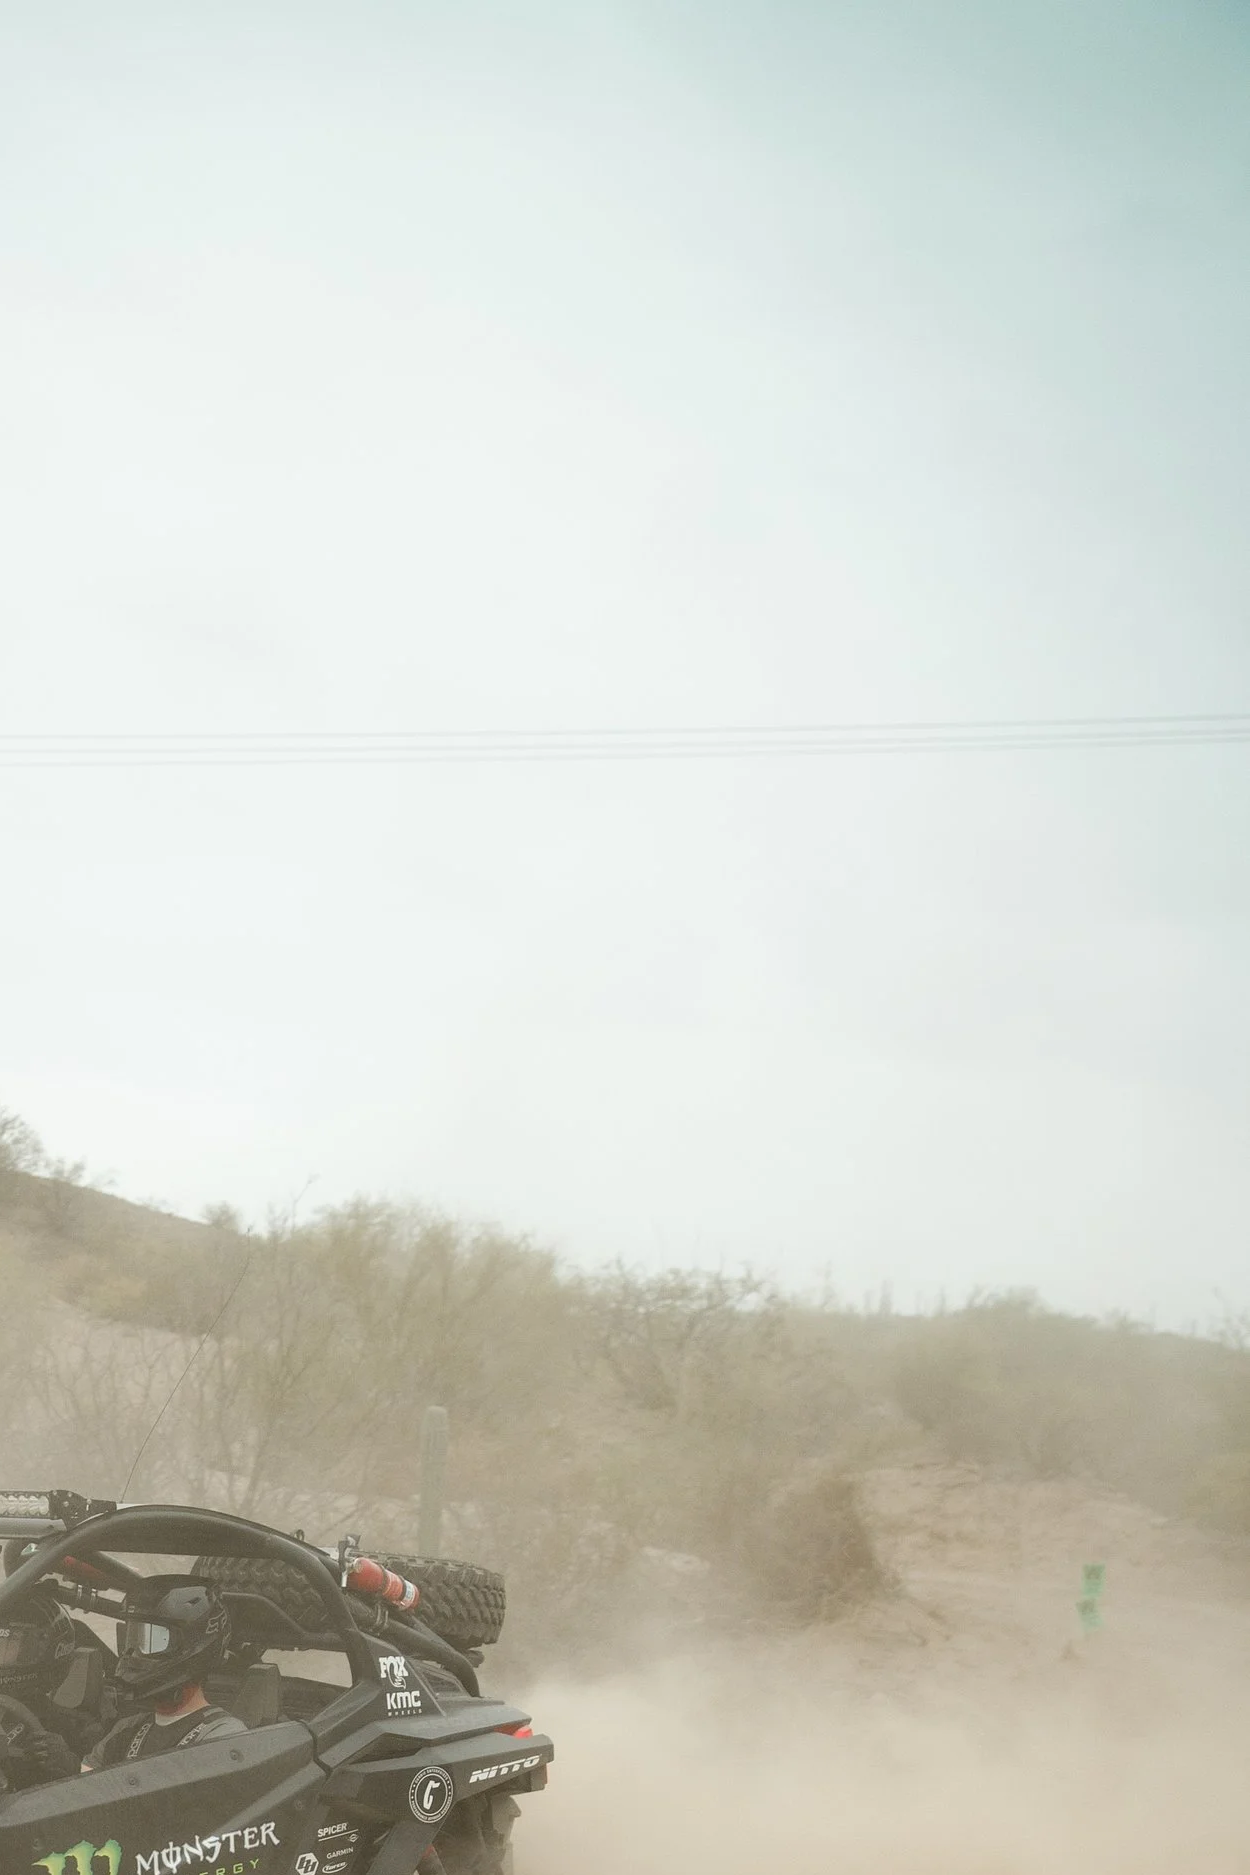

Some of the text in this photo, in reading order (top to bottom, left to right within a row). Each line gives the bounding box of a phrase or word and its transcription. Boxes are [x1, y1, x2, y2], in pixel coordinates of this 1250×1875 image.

[379, 1656, 409, 1685] FOX
[386, 1690, 422, 1710] KMC
[469, 1755, 542, 1784] NITTO
[317, 1822, 348, 1838] SPICER
[326, 1847, 354, 1859] GARMIN
